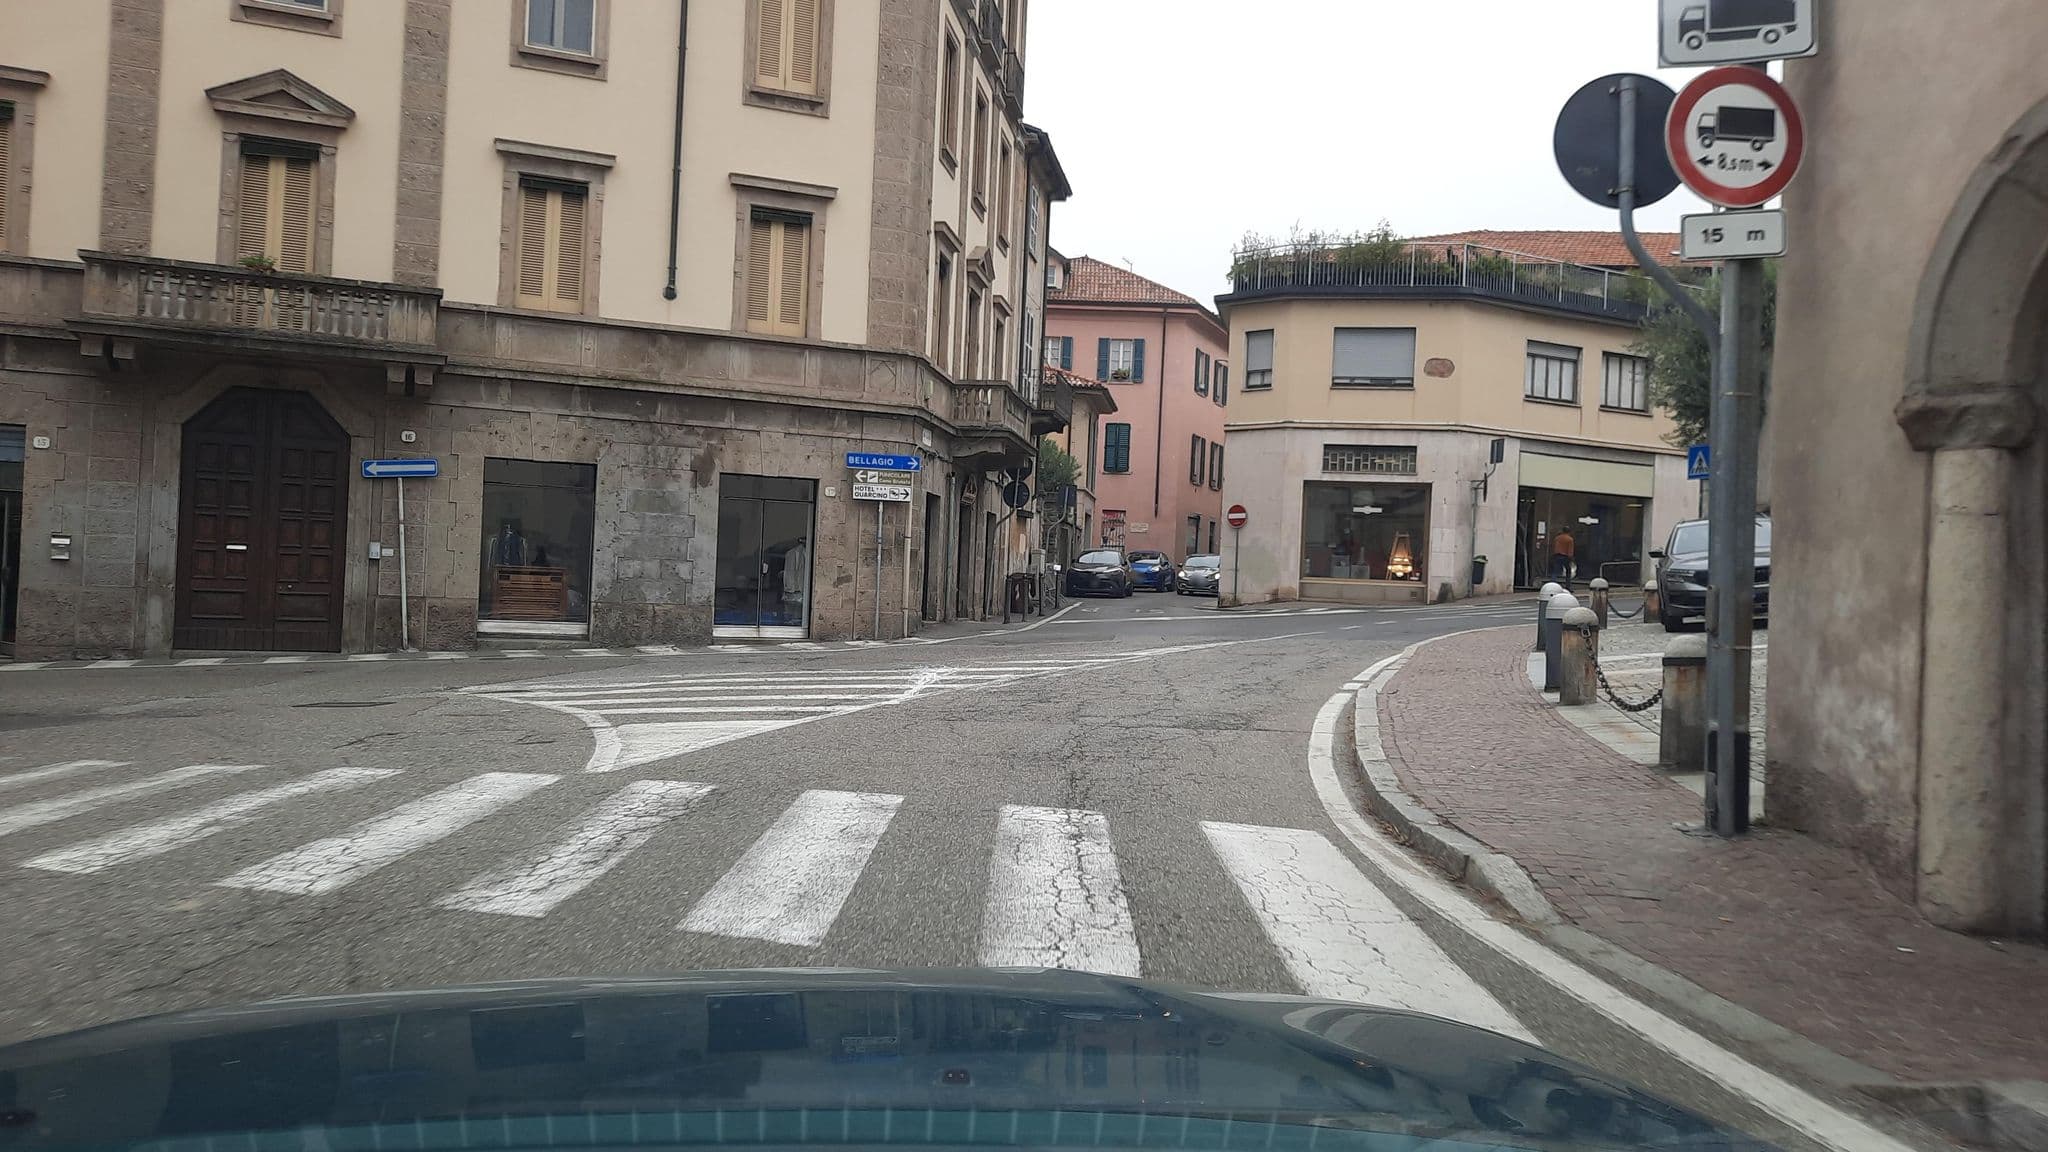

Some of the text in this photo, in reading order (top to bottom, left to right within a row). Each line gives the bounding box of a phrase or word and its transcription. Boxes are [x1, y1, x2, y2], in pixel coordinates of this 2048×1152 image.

[1702, 228, 1765, 243] 15 m
[848, 456, 894, 466] BELLAGIO
[854, 484, 874, 492] HOTEL
